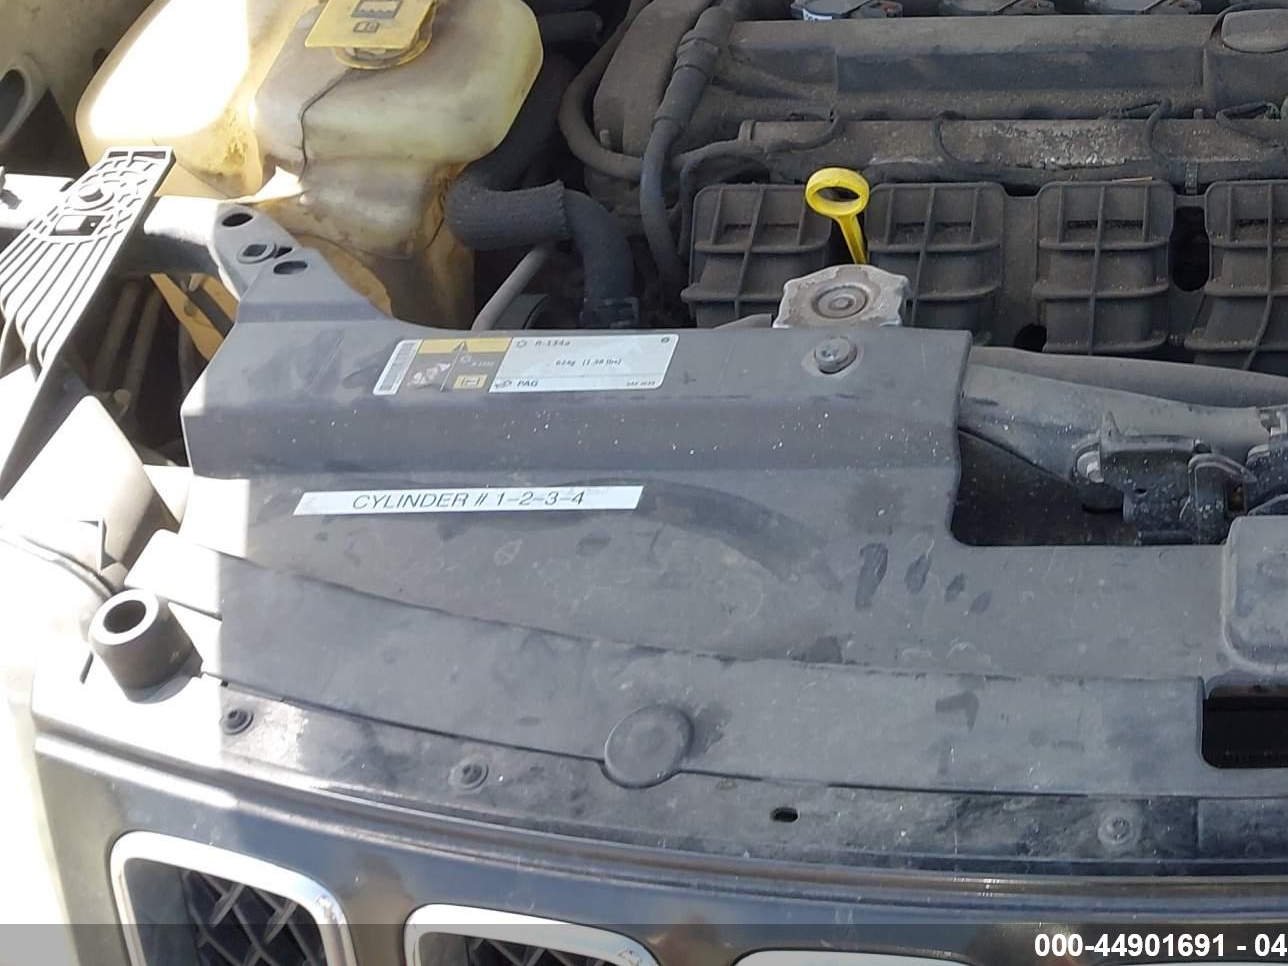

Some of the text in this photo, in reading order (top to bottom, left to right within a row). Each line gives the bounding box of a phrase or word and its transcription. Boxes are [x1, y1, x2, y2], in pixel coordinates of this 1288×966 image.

[516, 379, 539, 387] PAG
[353, 492, 469, 509] CYLINDER
[497, 490, 585, 506] 1-2-3-4
